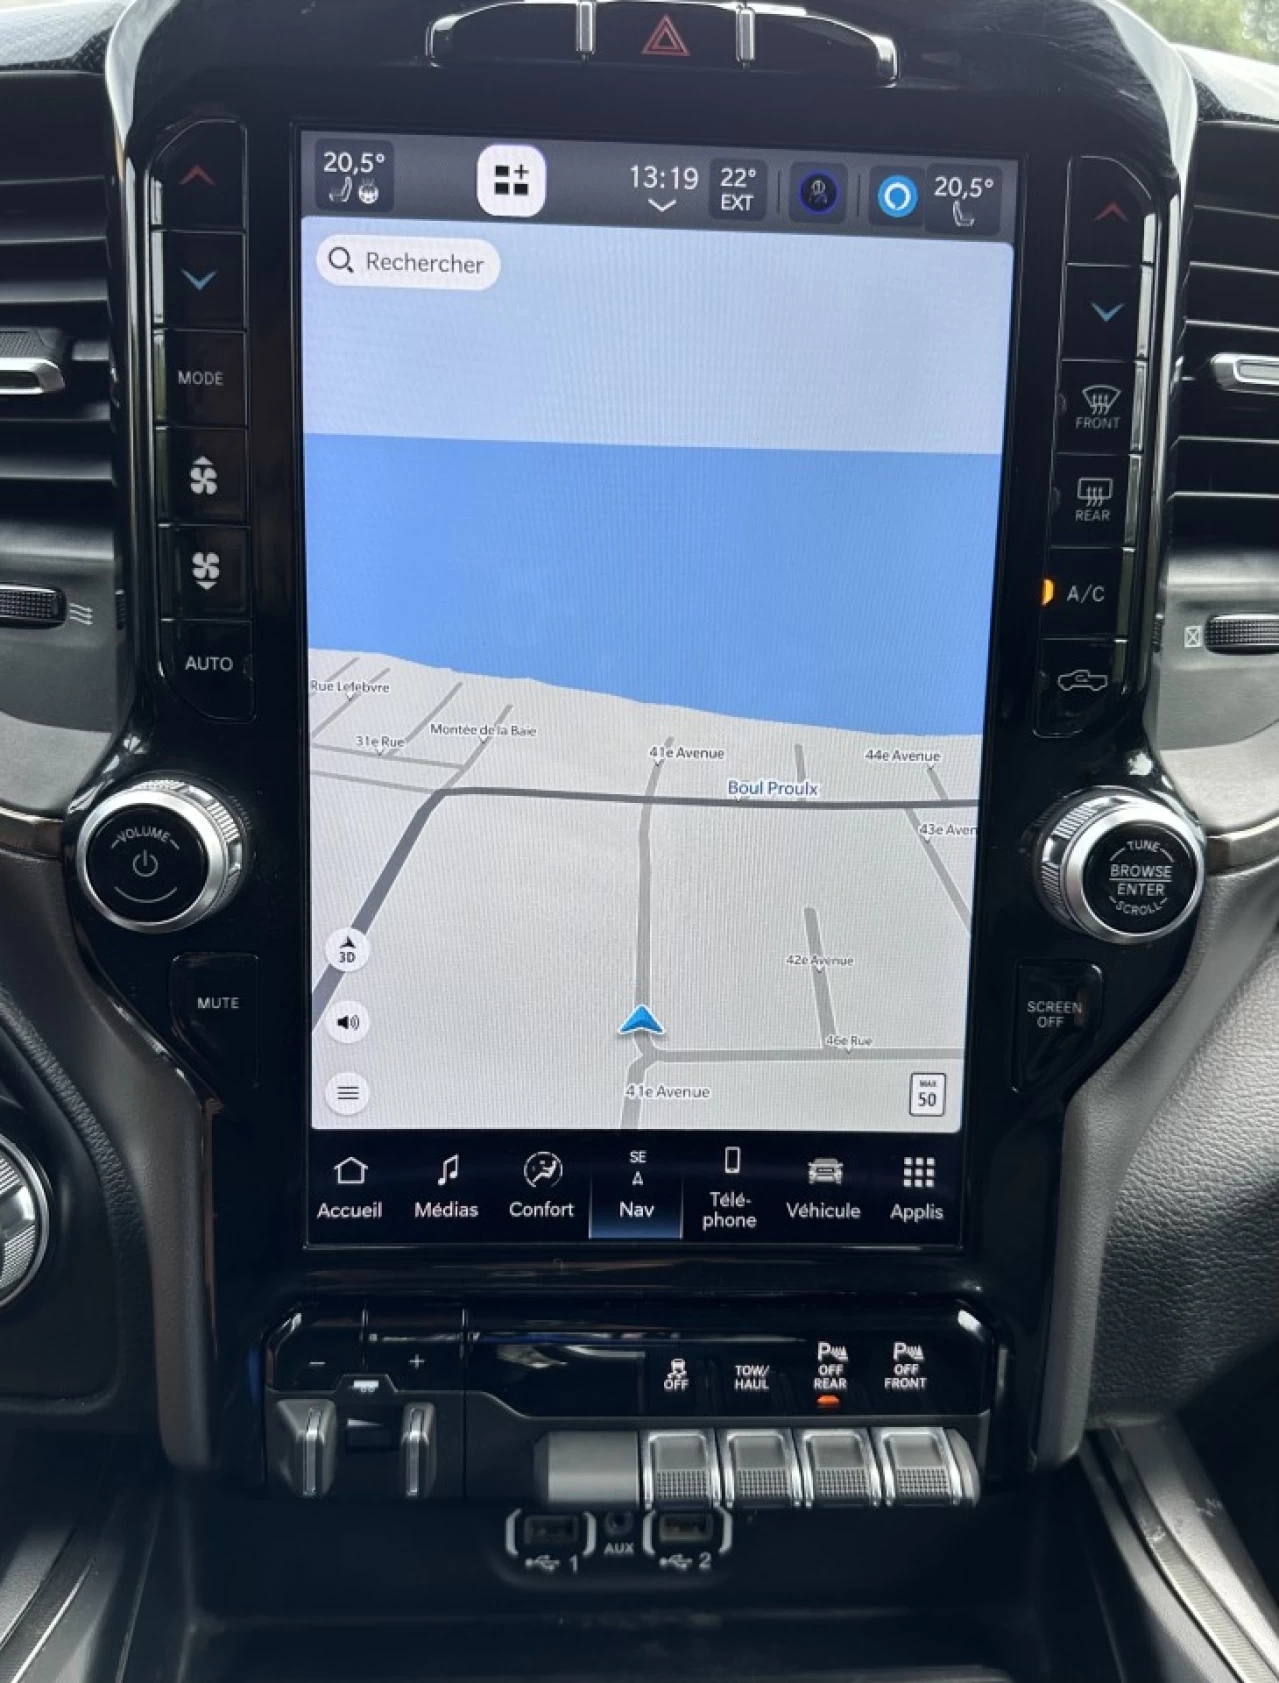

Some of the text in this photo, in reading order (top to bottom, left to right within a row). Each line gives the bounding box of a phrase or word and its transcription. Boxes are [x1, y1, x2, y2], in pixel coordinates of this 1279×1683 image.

[324, 151, 385, 176] 20,5°
[630, 164, 699, 190] 13:19
[720, 167, 756, 188] 22°
[933, 176, 994, 199] 20,5°
[721, 194, 754, 211] EXT
[366, 251, 484, 274] Rechercher
[178, 371, 224, 386] MODE
[1076, 417, 1121, 429] FRONT
[1076, 510, 1110, 522] REAR
[1067, 584, 1105, 603] A/C
[185, 656, 234, 671] AUTO
[310, 681, 390, 694] Rue Lefebvre
[430, 723, 537, 737] Montée de la Baie
[355, 736, 405, 748] 31e Rue
[650, 747, 725, 760] 41e Avenue
[865, 750, 941, 762] 44e Avenue
[728, 781, 818, 796] Boul Proulx
[117, 826, 171, 843] VOLUME
[919, 824, 943, 836] 43e
[1127, 839, 1160, 853] TUNE
[1110, 864, 1173, 879] BROWSE
[1117, 883, 1165, 897] ENTER
[1116, 901, 1162, 916] SCROLL
[339, 952, 356, 963] 3D
[786, 955, 854, 966] 42e Avenue
[197, 996, 240, 1009] MUTE
[1027, 1000, 1082, 1014] SCREEN
[1036, 1016, 1065, 1028] OFF
[827, 1035, 873, 1046] 46e Rue
[919, 1079, 938, 1088] MAX
[626, 1085, 710, 1099] 41e Avenue
[918, 1092, 937, 1107] 50
[629, 1151, 647, 1163] SE
[632, 1171, 644, 1186] A
[709, 1190, 752, 1207] Télé-
[317, 1202, 383, 1218] Accueil
[414, 1200, 479, 1218] Médias
[509, 1200, 575, 1218] Confort
[619, 1201, 655, 1218] Nav
[786, 1201, 861, 1219] Véhicule
[889, 1203, 944, 1222] Applis
[702, 1213, 758, 1231] phone
[735, 1365, 770, 1377] TOW/
[818, 1364, 844, 1376] OFF
[894, 1364, 919, 1376] OFF
[663, 1379, 690, 1391] OFF
[735, 1378, 770, 1390] HAUL
[813, 1378, 847, 1390] REAR
[884, 1377, 928, 1390] FRONT
[604, 1542, 636, 1555] AUX
[569, 1555, 579, 1575] 1
[698, 1551, 712, 1571] 2
